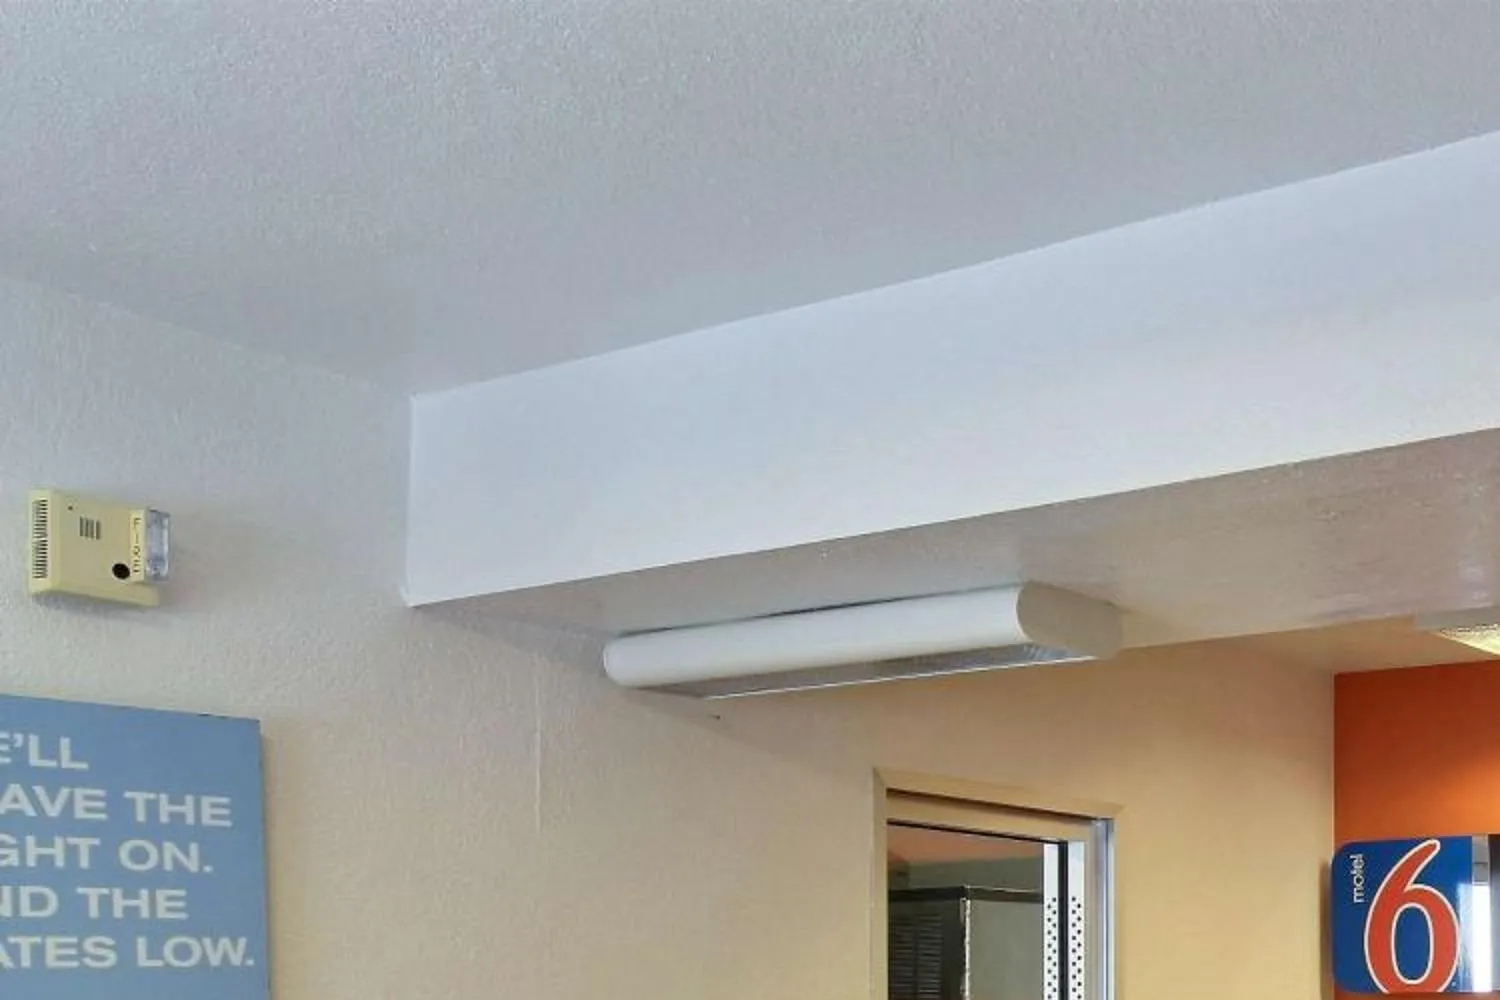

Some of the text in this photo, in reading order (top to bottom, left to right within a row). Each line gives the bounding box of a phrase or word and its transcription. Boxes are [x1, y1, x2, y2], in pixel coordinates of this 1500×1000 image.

[0, 783, 233, 827] AVE THE
[118, 839, 213, 873] ON.
[76, 887, 189, 920] THE
[1350, 839, 1461, 993] motel 6
[136, 936, 255, 968] LOW.
